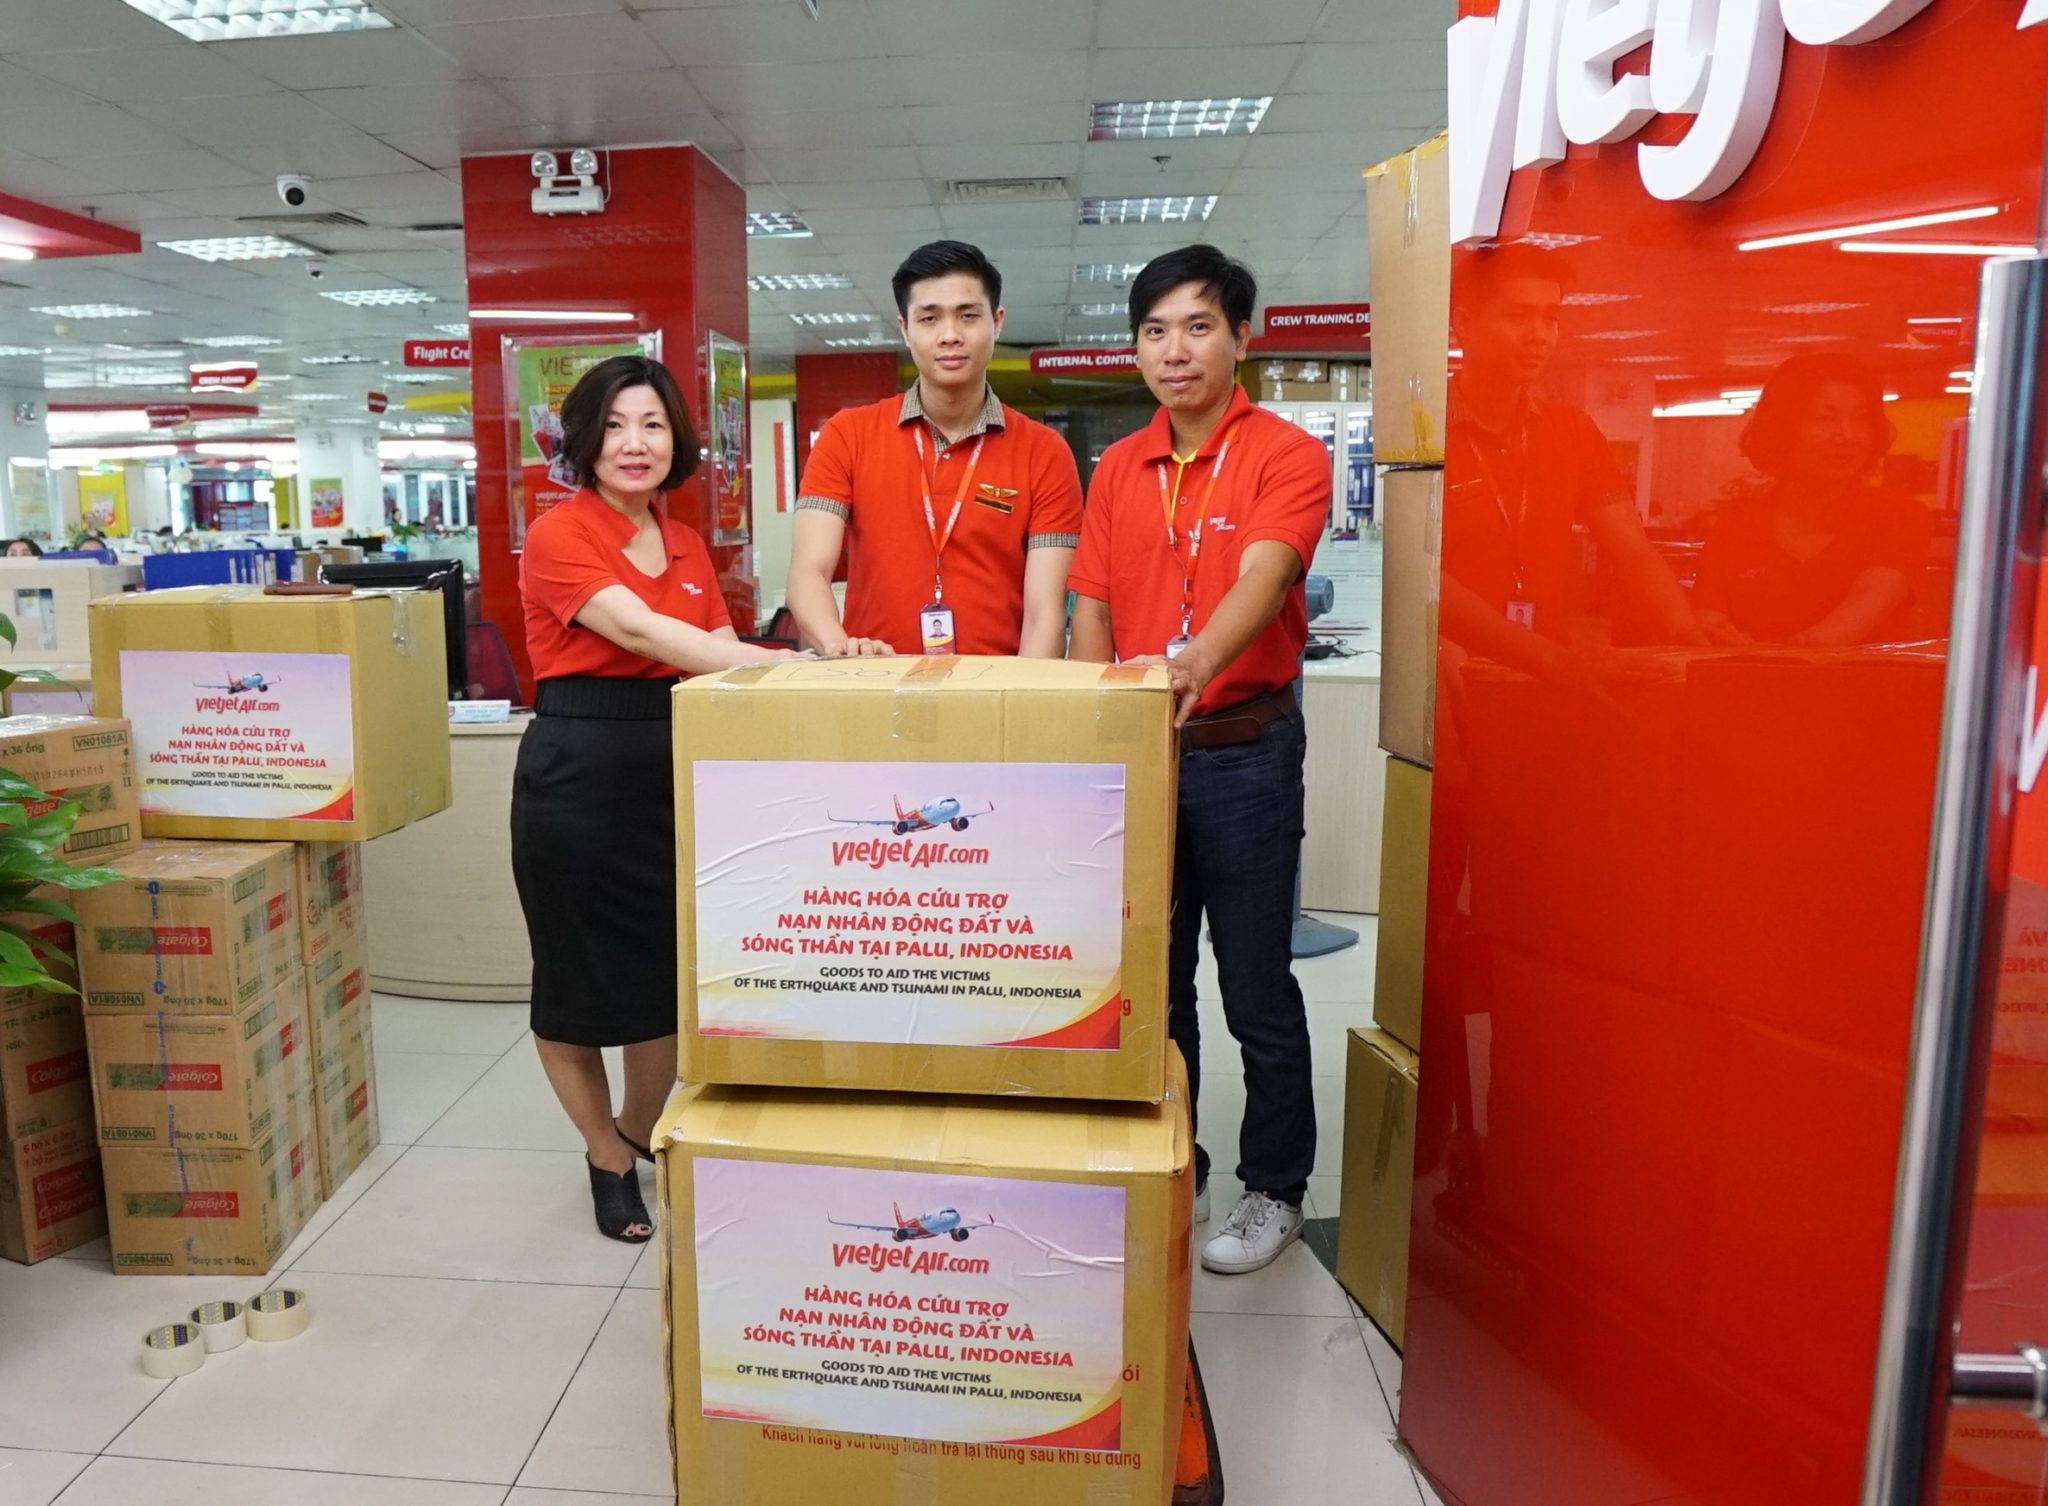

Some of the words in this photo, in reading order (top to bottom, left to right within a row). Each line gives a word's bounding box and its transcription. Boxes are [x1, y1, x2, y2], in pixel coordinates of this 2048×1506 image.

[1270, 315, 1302, 327] CREW
[1304, 313, 1354, 326] TRAINING
[413, 346, 448, 362] Flight
[1038, 355, 1094, 368] INTERNAL
[182, 724, 212, 736] HÀNG
[216, 724, 239, 736] HÓA
[243, 724, 265, 737] CỨU
[268, 727, 290, 740] TRỢ
[169, 739, 192, 751] NẠN
[195, 740, 226, 750] NHÂN
[230, 741, 262, 752] ĐỘNG
[266, 739, 287, 752] ĐẤT
[291, 741, 305, 752] VÀ
[150, 753, 177, 764] SÓNG
[180, 752, 209, 764] THẦN
[214, 755, 229, 767] TẠI
[233, 756, 263, 767] PALU,
[267, 757, 326, 768] INDONESIA
[803, 887, 861, 907] HÀNG
[867, 889, 911, 907] HÓA
[917, 887, 960, 908] CỨU
[966, 893, 1008, 909] TRỢ
[778, 913, 821, 933] NẠN
[827, 914, 886, 931] NHÂN
[892, 915, 953, 936] ĐỘNG
[959, 911, 1001, 933] ĐẤT
[1007, 915, 1033, 934] VÀ
[157, 933, 208, 948] Colgate
[743, 936, 793, 954] SÓNG
[801, 933, 854, 955] THẦN
[860, 940, 890, 960] TẠI
[896, 942, 954, 959] PALU,
[960, 943, 1072, 960] INDONESIA
[820, 967, 864, 978] GOODS
[867, 968, 883, 978] TO
[886, 969, 909, 979] AID
[913, 969, 937, 980] THE
[940, 970, 990, 981] VICTIMS
[734, 978, 750, 987] OF
[753, 979, 777, 989] THE
[780, 980, 856, 993] ERTHQUAKE
[859, 982, 889, 993] AND
[891, 983, 948, 994] TSUNAMI
[952, 985, 965, 995] IN
[969, 986, 1006, 998] PALU,
[1010, 987, 1081, 998] INDONESIA
[168, 1070, 218, 1084] Colgate
[185, 1198, 235, 1211] Colgate
[804, 1284, 862, 1307] HÀNG
[868, 1289, 911, 1308] HÓA
[917, 1293, 960, 1314] CỨU
[968, 1301, 1008, 1317] TRỢ
[780, 1307, 822, 1326] NẠN
[828, 1309, 886, 1330] NHÂN
[893, 1317, 953, 1337] ĐỘNG
[960, 1318, 1000, 1340] ĐẤT
[1008, 1322, 1033, 1340] VÀ
[745, 1325, 795, 1346] SÓNG
[802, 1327, 855, 1352] THẦN
[862, 1339, 890, 1358] TẠI
[897, 1340, 955, 1361] PALU,
[961, 1348, 1072, 1366] INDONESIA
[822, 1360, 865, 1373] GOODS
[868, 1365, 884, 1374] TO
[887, 1367, 910, 1377] AID
[913, 1369, 938, 1380] THE
[941, 1371, 991, 1383] VICTIMS
[737, 1364, 753, 1374] OF
[755, 1367, 779, 1377] THE
[782, 1369, 858, 1385] ERTHQUAKE
[861, 1378, 889, 1388] AND
[892, 1380, 949, 1394] TSUNAMI
[953, 1386, 966, 1395] IN
[970, 1387, 1007, 1399] PALU,
[1011, 1390, 1082, 1402] INDONESIA
[1030, 1450, 1054, 1463] sau
